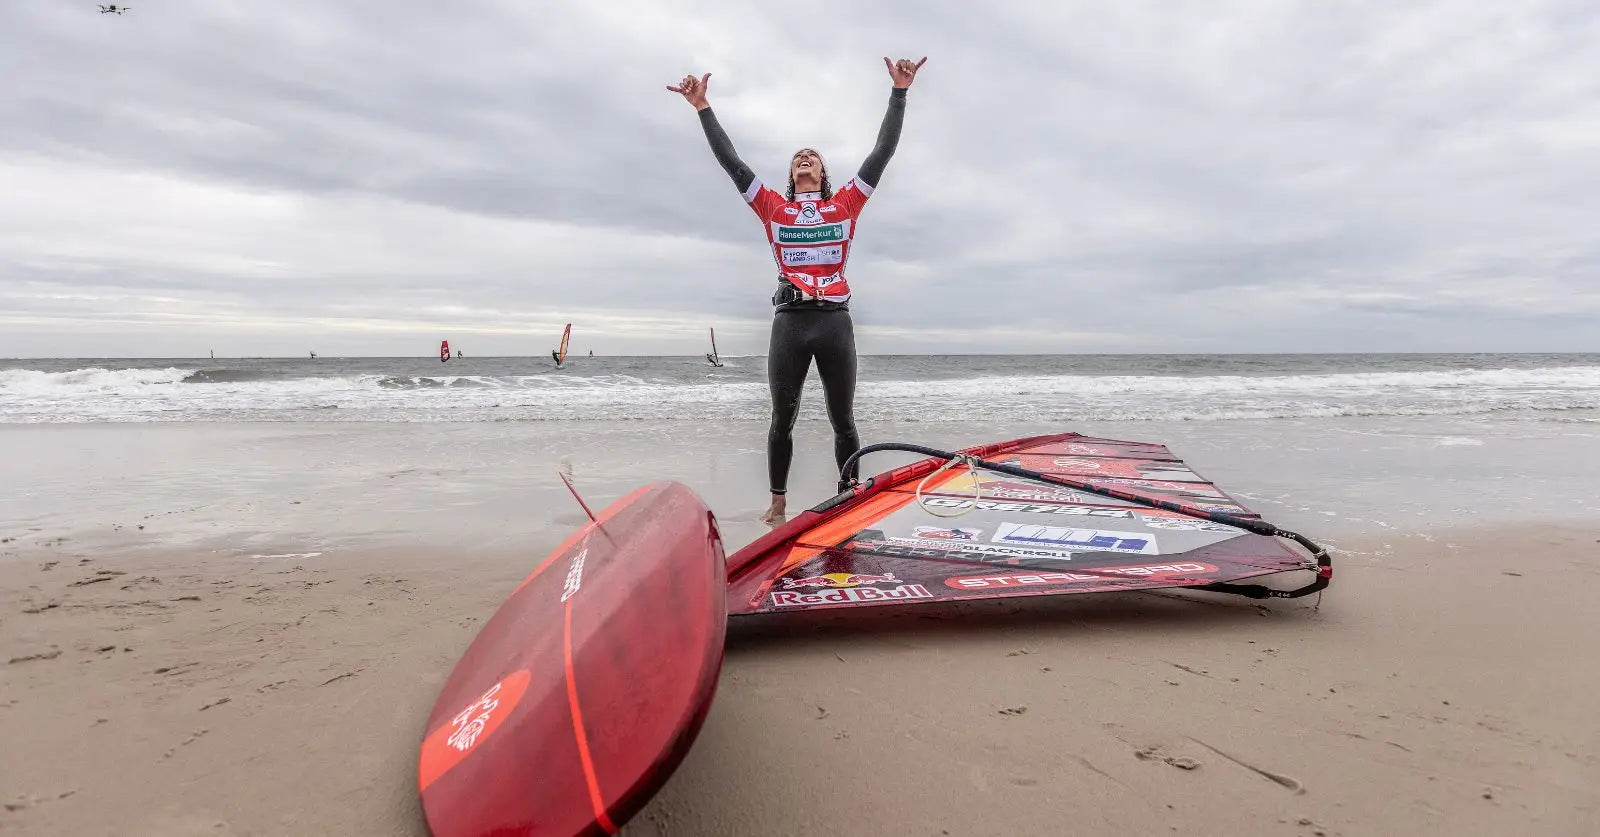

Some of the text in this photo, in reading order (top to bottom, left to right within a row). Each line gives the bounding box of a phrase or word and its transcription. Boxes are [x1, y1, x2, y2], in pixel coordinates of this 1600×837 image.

[780, 229, 832, 239] HanseMerkur
[962, 545, 1068, 558] BLACKROLL
[958, 562, 1206, 588] STARBARD
[773, 589, 847, 606] Red
[853, 584, 930, 602] Bull
